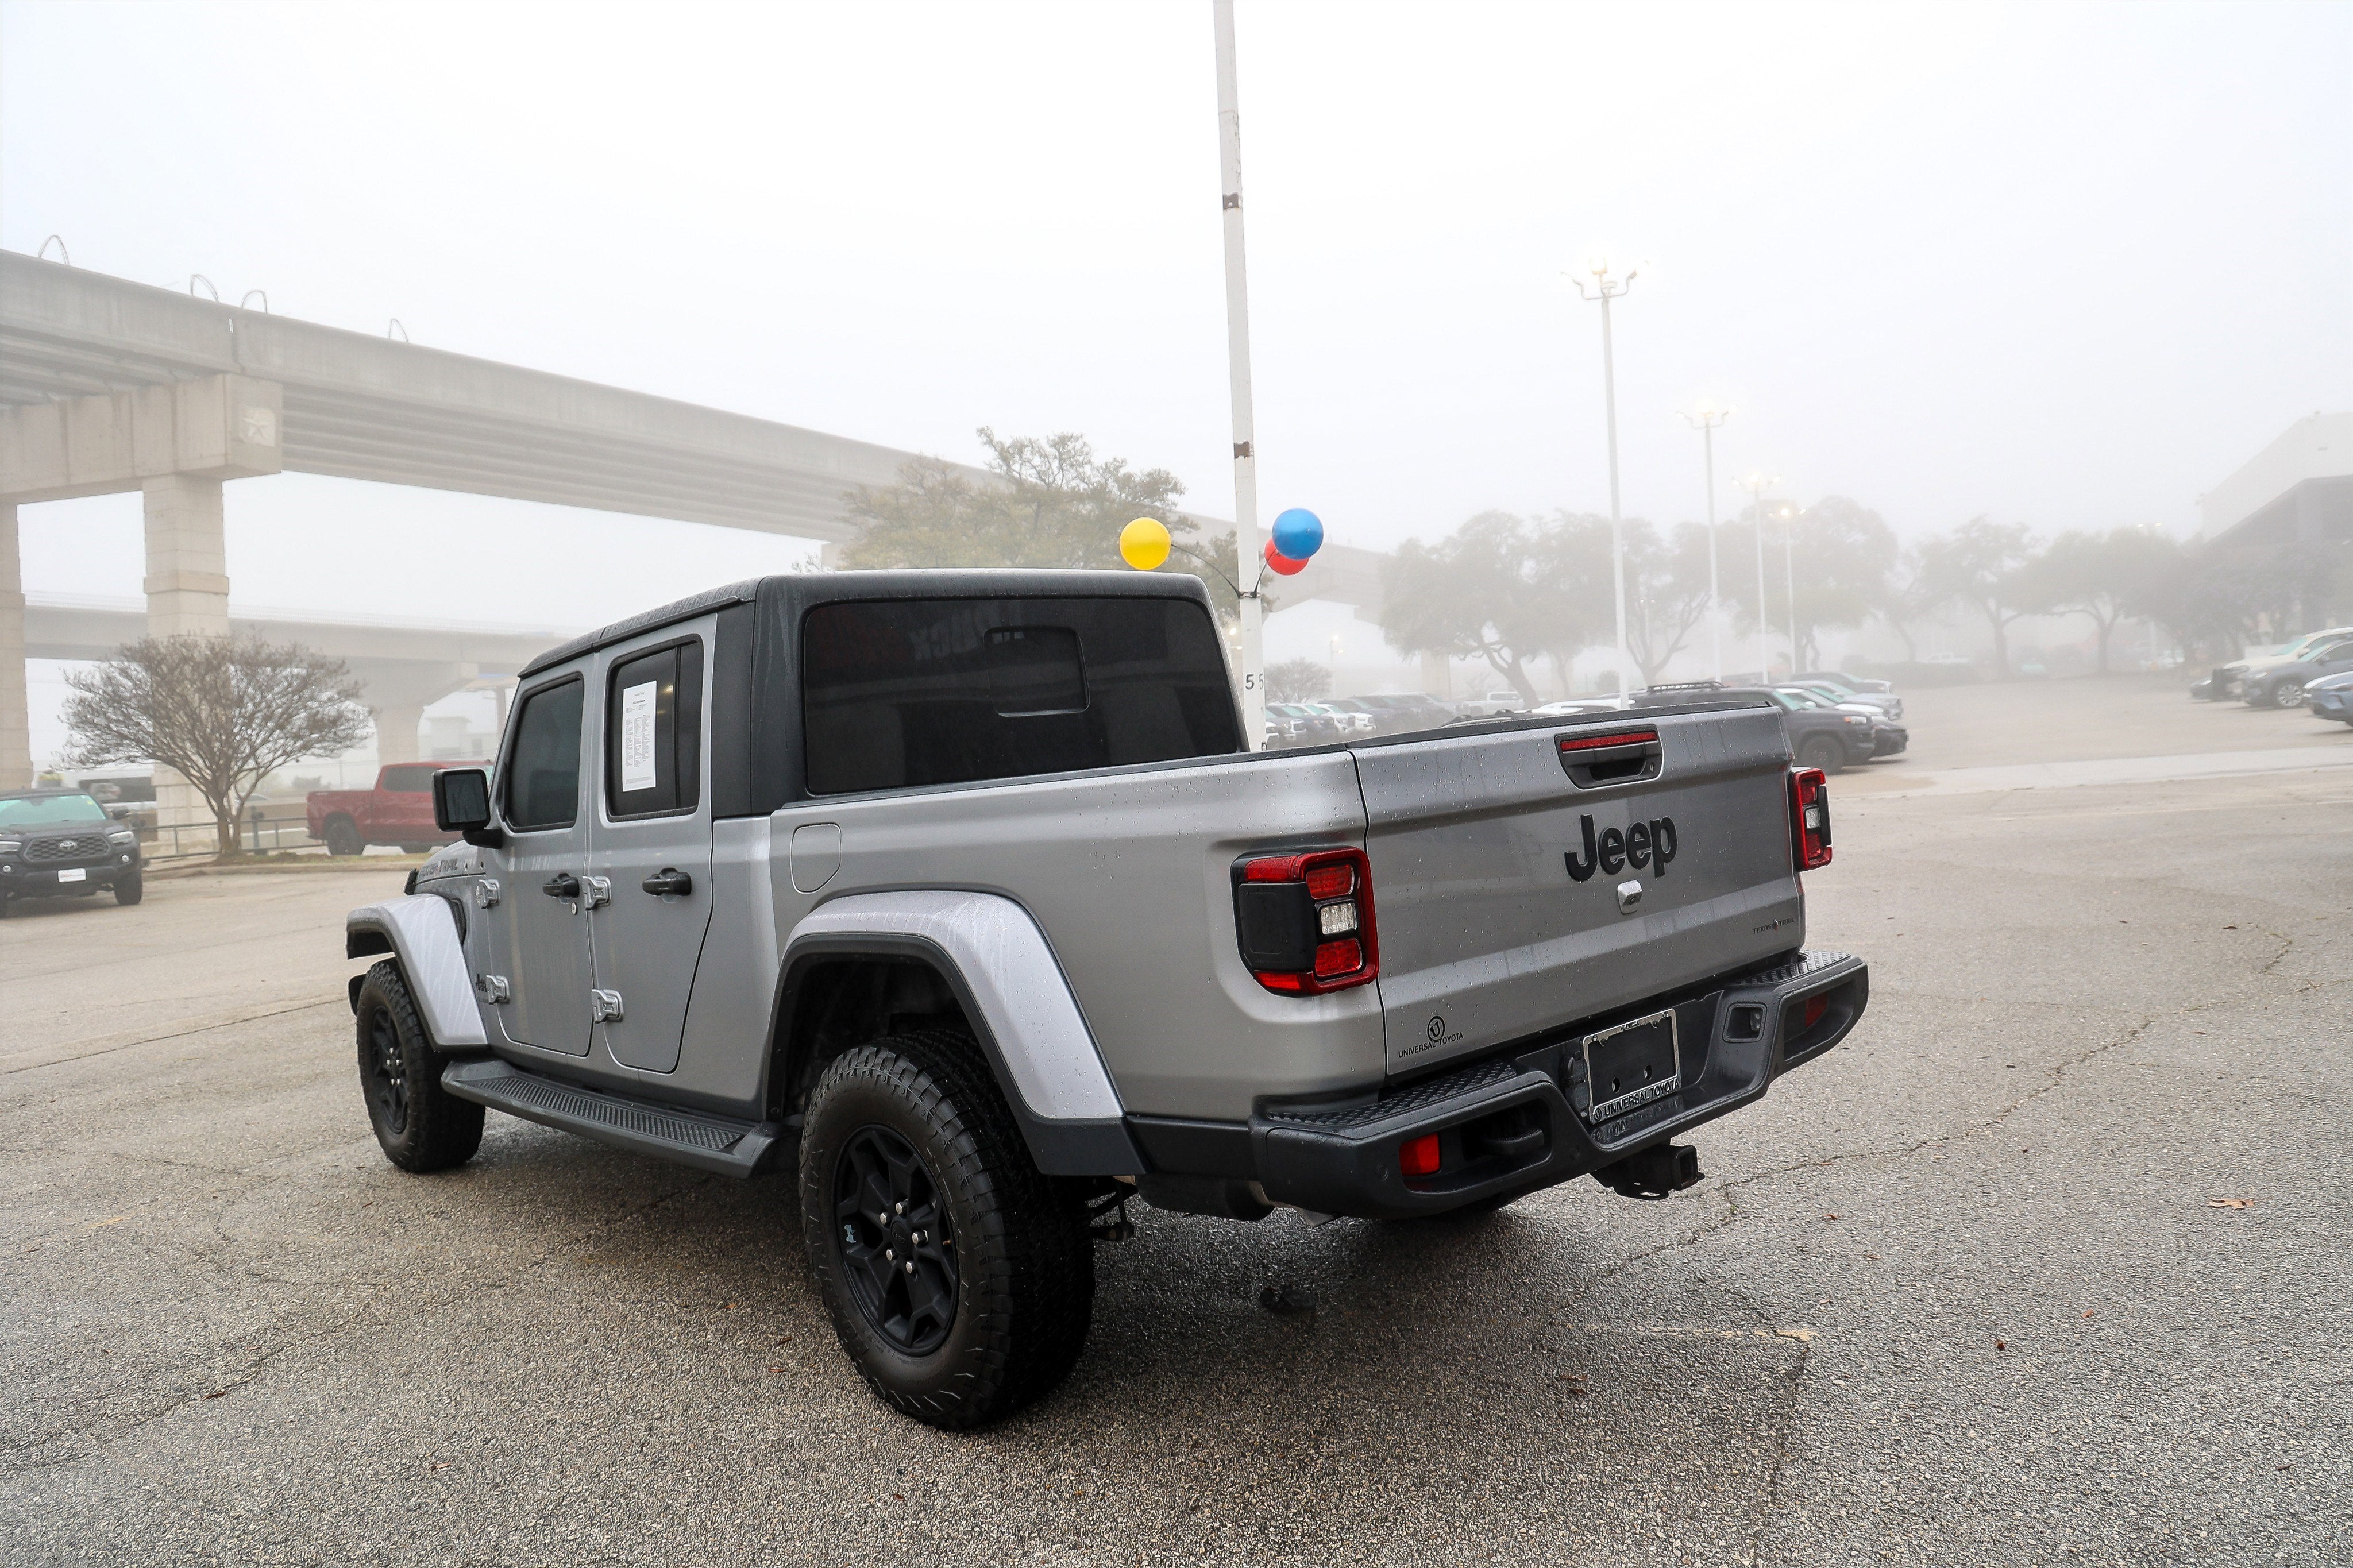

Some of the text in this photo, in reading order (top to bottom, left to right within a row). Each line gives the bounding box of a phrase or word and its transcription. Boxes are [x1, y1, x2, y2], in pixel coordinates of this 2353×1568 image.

[1564, 813, 1677, 883] Jeep
[1752, 918, 1794, 934] TEXAS TRAIL
[1398, 1032, 1464, 1058] UNIVERSAL TOYOTA
[1604, 1091, 1649, 1116] UNIVERSAL
[1649, 1077, 1680, 1098] TOYOTA
